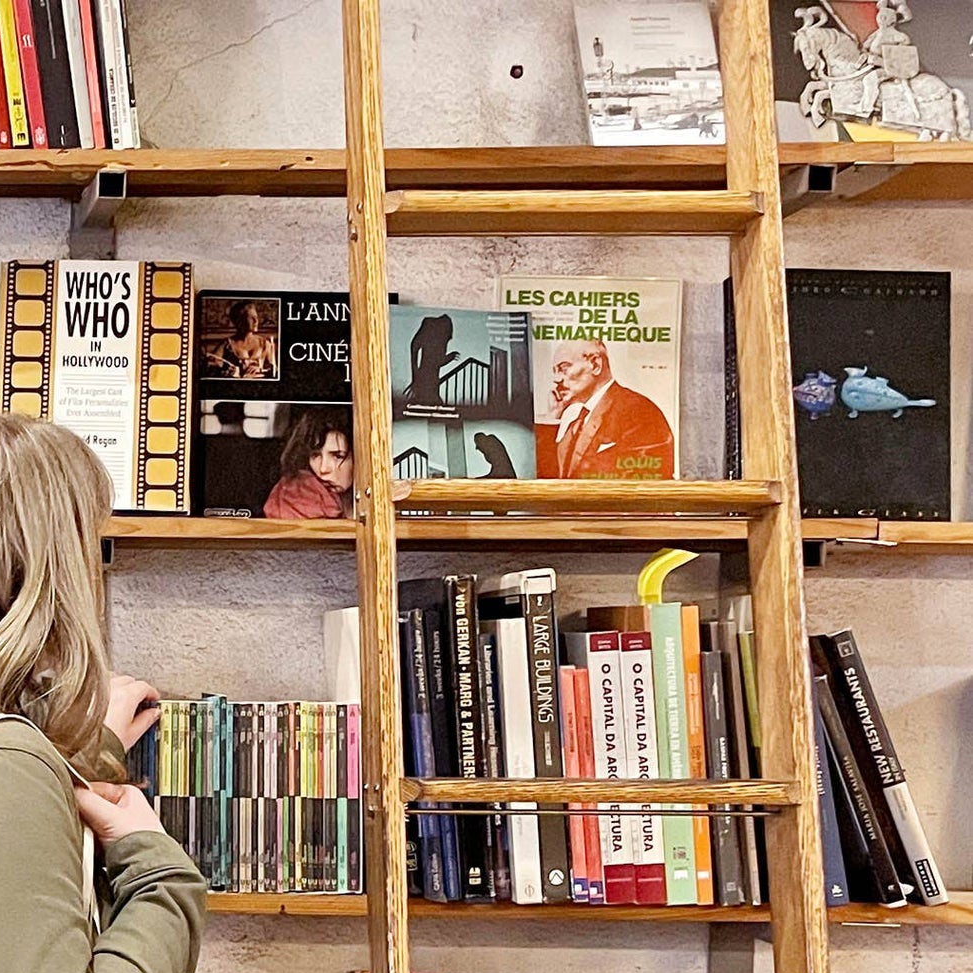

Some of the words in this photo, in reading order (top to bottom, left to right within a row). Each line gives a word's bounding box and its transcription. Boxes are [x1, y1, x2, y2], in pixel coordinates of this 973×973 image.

[65, 271, 131, 300] WHO'S
[506, 290, 544, 306] LES
[548, 291, 640, 307] CAHIERS
[64, 301, 130, 338] WHO
[578, 308, 608, 325] DE
[611, 308, 639, 325] LA
[90, 340, 102, 352] IN
[62, 355, 129, 368] HOLLYWOOD
[65, 387, 79, 398] The
[81, 387, 106, 400] Largest
[616, 455, 662, 470] LOUIS
[455, 593, 467, 616] von
[457, 617, 472, 666] GERKAN
[532, 615, 550, 656] LARGE
[601, 663, 612, 674] O
[632, 663, 643, 674] O
[664, 636, 676, 697] ARQUITECTURA
[458, 673, 472, 704] MARG
[536, 659, 554, 724] BUILDINGS
[460, 710, 470, 719] &
[602, 677, 615, 731] CAPITAL
[633, 677, 646, 730] CAPITAL
[668, 698, 677, 710] DE
[844, 667, 880, 753] RESTAURANTS
[668, 711, 679, 738] TIERRA
[461, 721, 476, 779] PARTNERS
[605, 733, 617, 753] DA
[636, 733, 648, 752] DA
[670, 739, 679, 750] EN
[875, 754, 895, 785] NEW
[863, 817, 878, 841] MARIA
